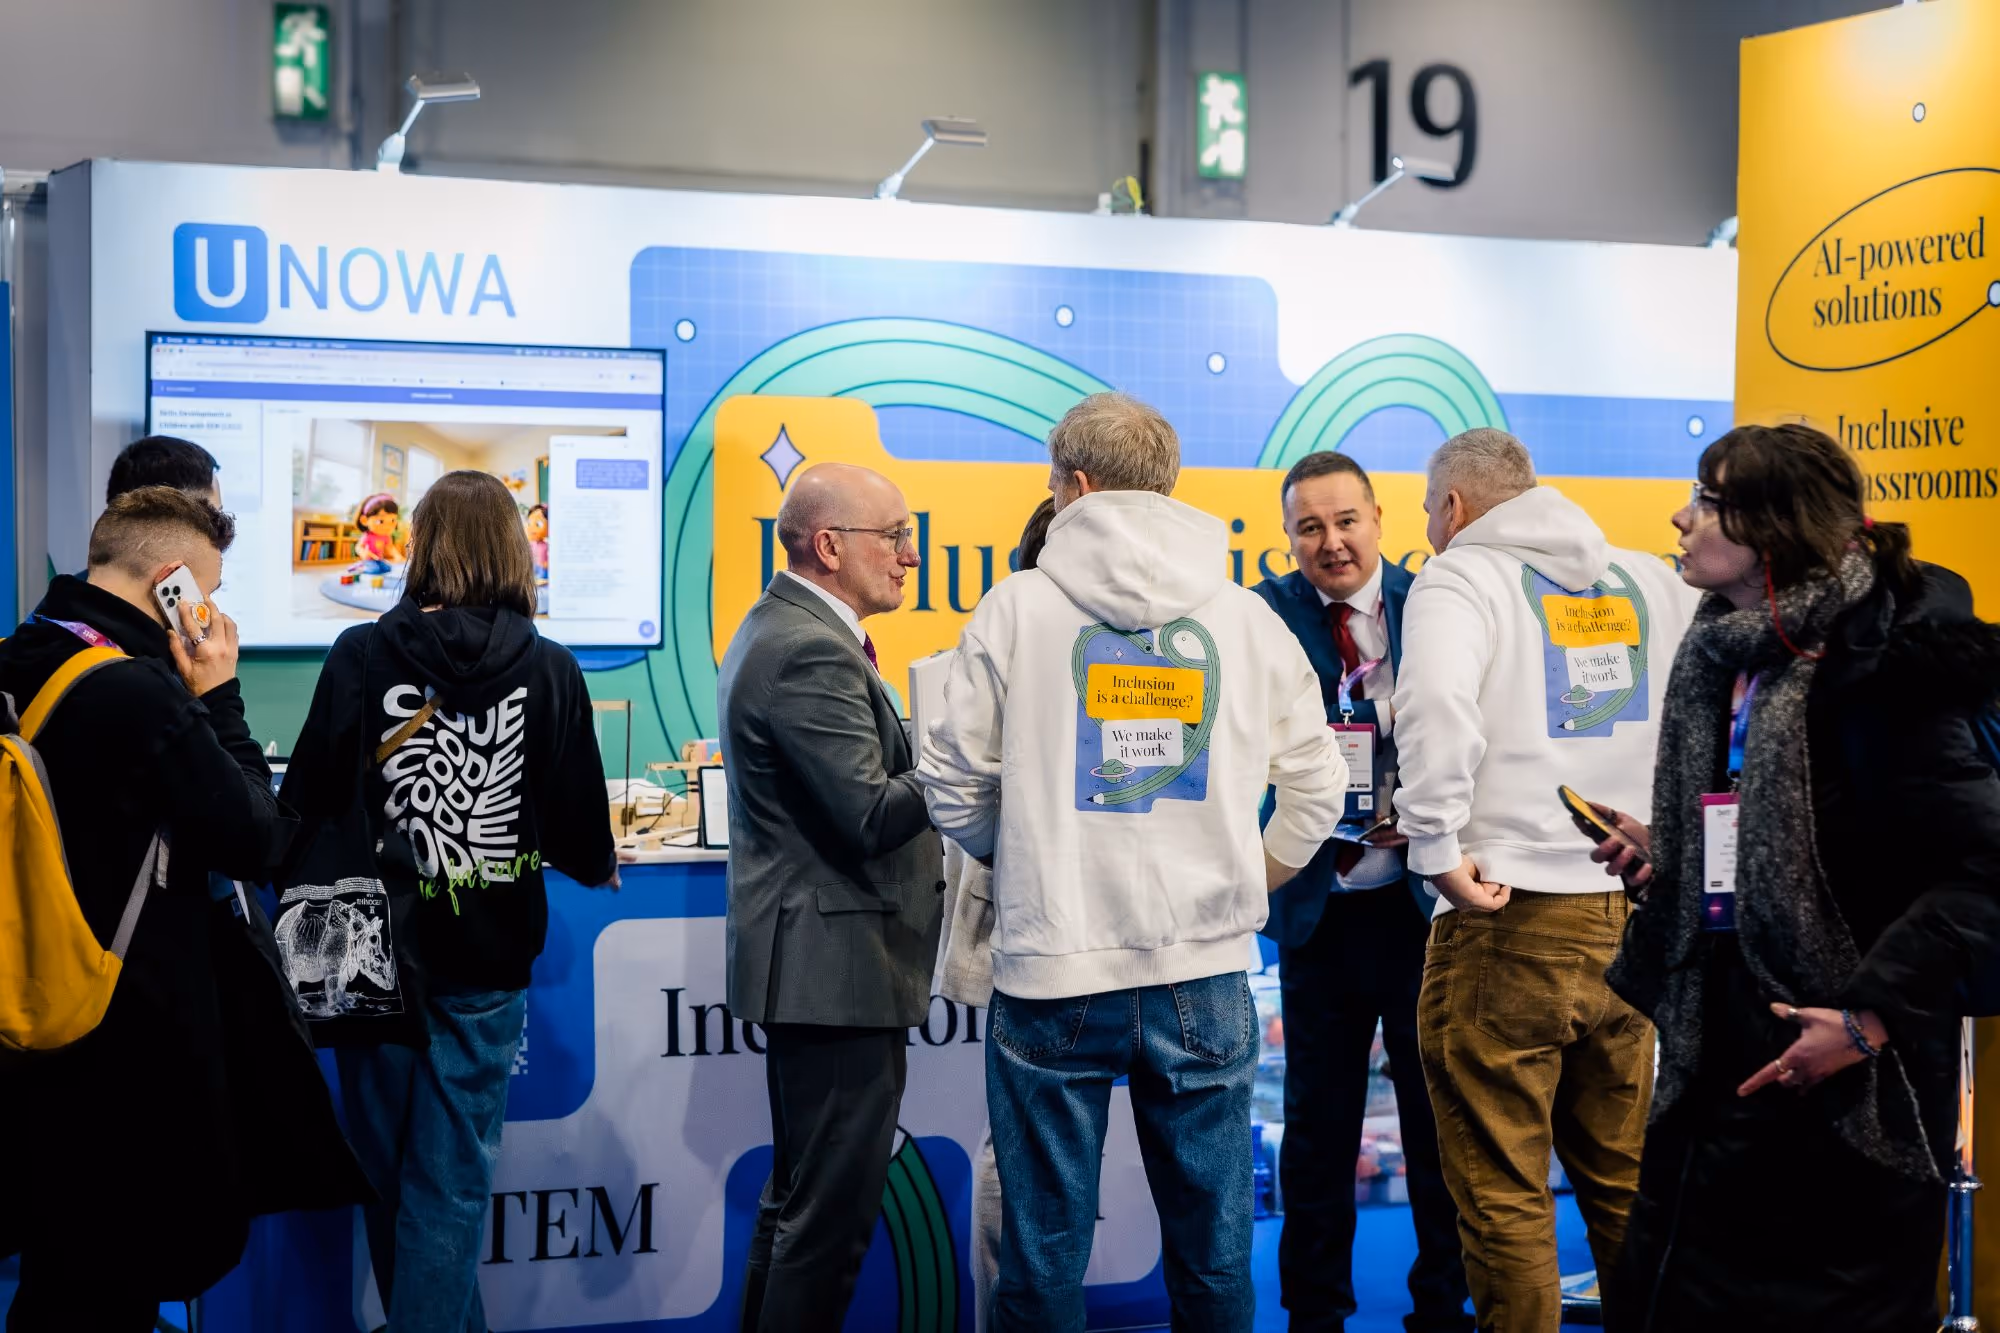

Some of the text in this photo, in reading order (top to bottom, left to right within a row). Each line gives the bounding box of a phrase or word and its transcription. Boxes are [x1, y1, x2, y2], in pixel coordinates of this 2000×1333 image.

[1348, 58, 1478, 190] 19
[1813, 216, 1986, 280] AI-powered
[194, 236, 517, 318] UNOWA
[1813, 281, 1943, 329] solutions
[1837, 406, 1965, 451] Inclusive
[1864, 466, 1998, 502] assrooms
[1564, 604, 1615, 619] Inclusion
[1556, 618, 1631, 633] is a challenge?
[1574, 652, 1621, 668] We make
[1112, 674, 1175, 691] Inclusion
[1582, 669, 1619, 684] it work
[1096, 689, 1194, 709] is a challenge?
[1112, 727, 1173, 742] We make
[1120, 743, 1166, 758] it work
[481, 1182, 660, 1265] TEM
